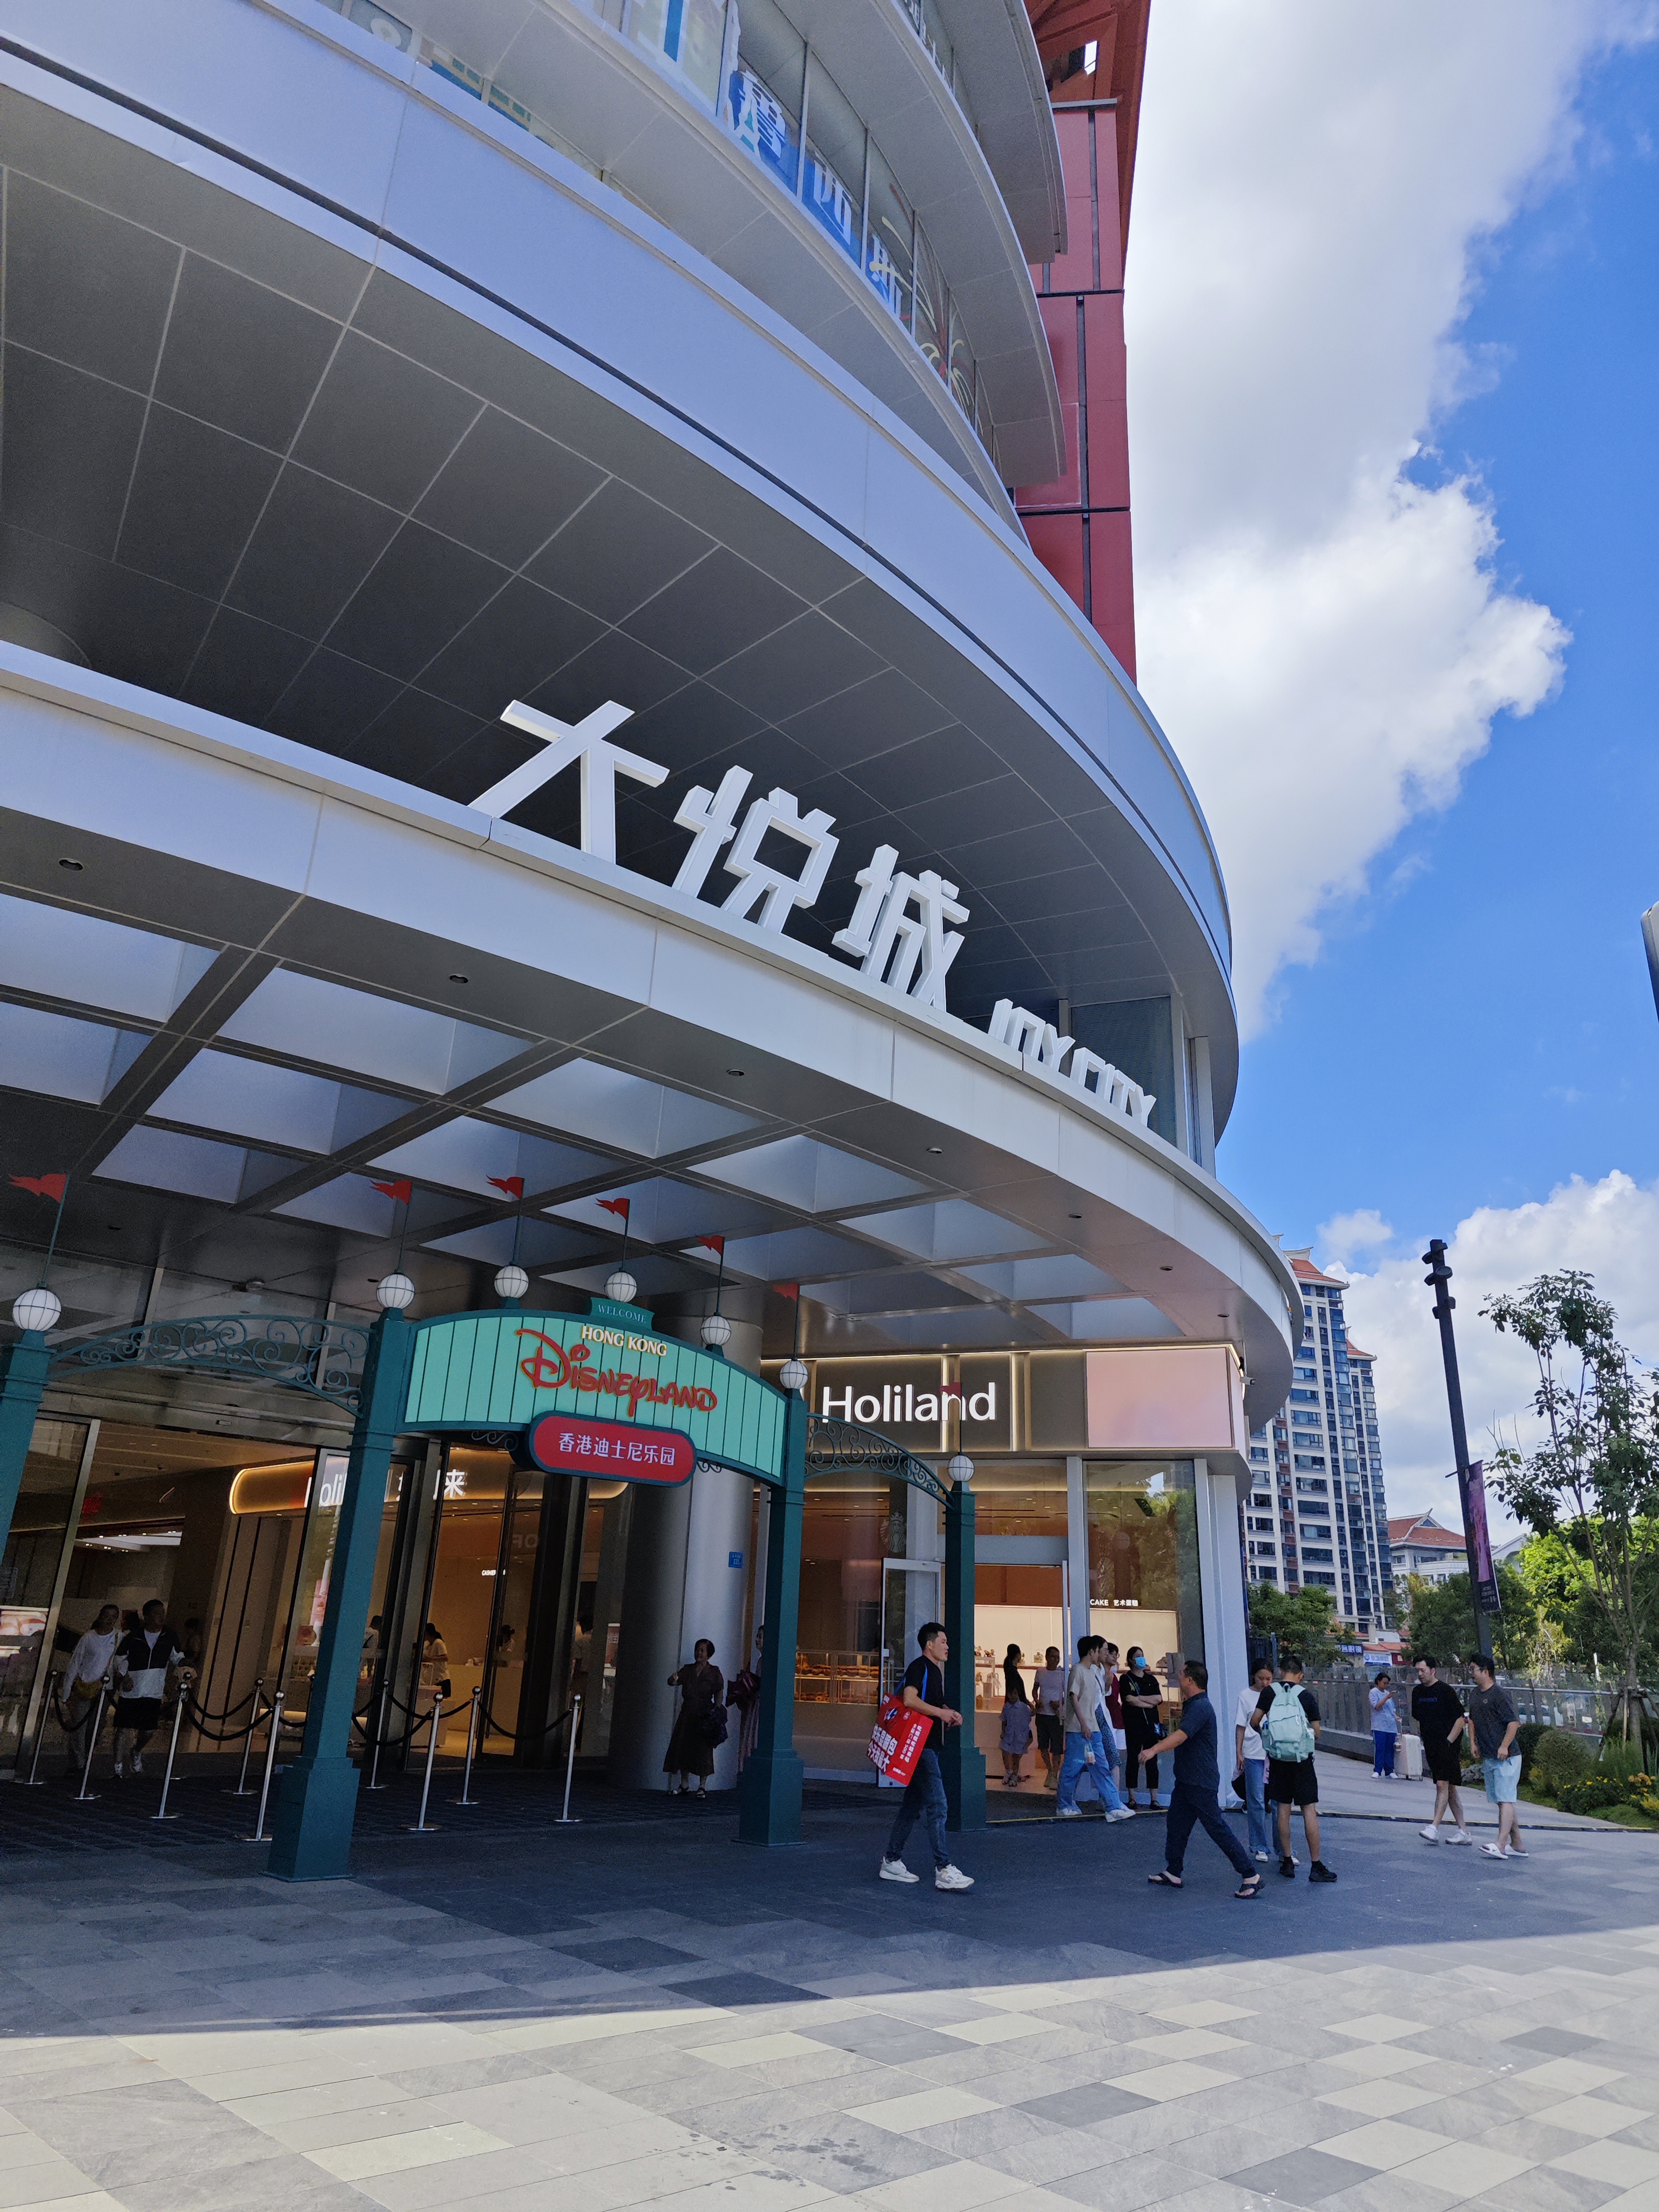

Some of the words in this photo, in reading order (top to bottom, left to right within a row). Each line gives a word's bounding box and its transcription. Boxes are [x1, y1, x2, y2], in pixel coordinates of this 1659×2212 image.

[468, 699, 970, 1013] 大悦城
[1070, 1047, 1157, 1127] CITY
[597, 1304, 647, 1324] WELCOME
[582, 1326, 624, 1345] HONG
[628, 1335, 667, 1356] KONG
[822, 1382, 996, 1422] Holiland
[558, 1432, 675, 1466] 香港迪士尼乐园
